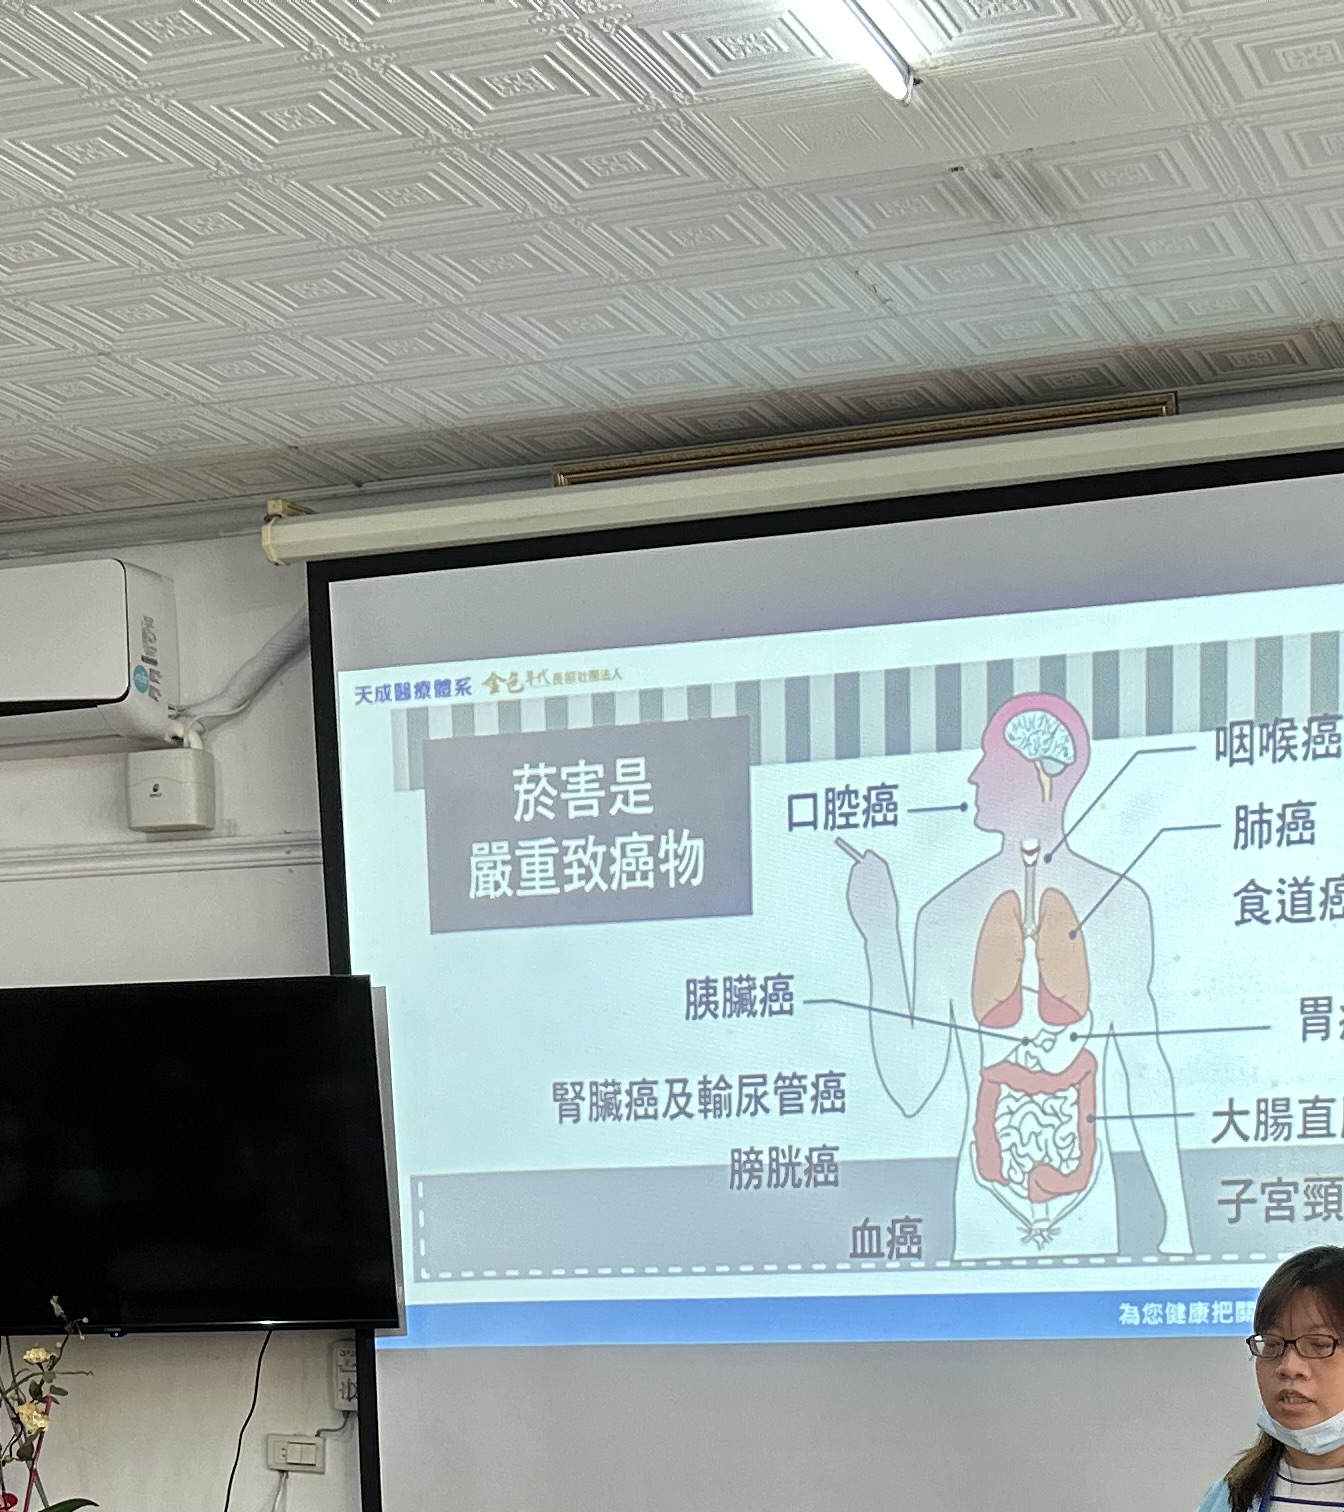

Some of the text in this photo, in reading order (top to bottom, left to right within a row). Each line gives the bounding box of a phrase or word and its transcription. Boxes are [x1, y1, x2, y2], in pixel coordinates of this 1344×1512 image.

[354, 676, 473, 706] 天成醫療體系
[1214, 712, 1344, 768] 咽喉癌
[512, 755, 655, 823] 菸害是
[787, 781, 899, 832] 口腔癌
[1232, 799, 1318, 851] 肺癌
[467, 828, 706, 900] 嚴重致癌物
[684, 972, 795, 1021] 胰臟癌
[551, 1069, 847, 1125] 腎臟癌及輸尿管癌
[729, 1143, 840, 1190] 膀胱癌
[849, 1215, 923, 1260] 血癌
[1119, 1300, 1256, 1326] 為您健康把關
